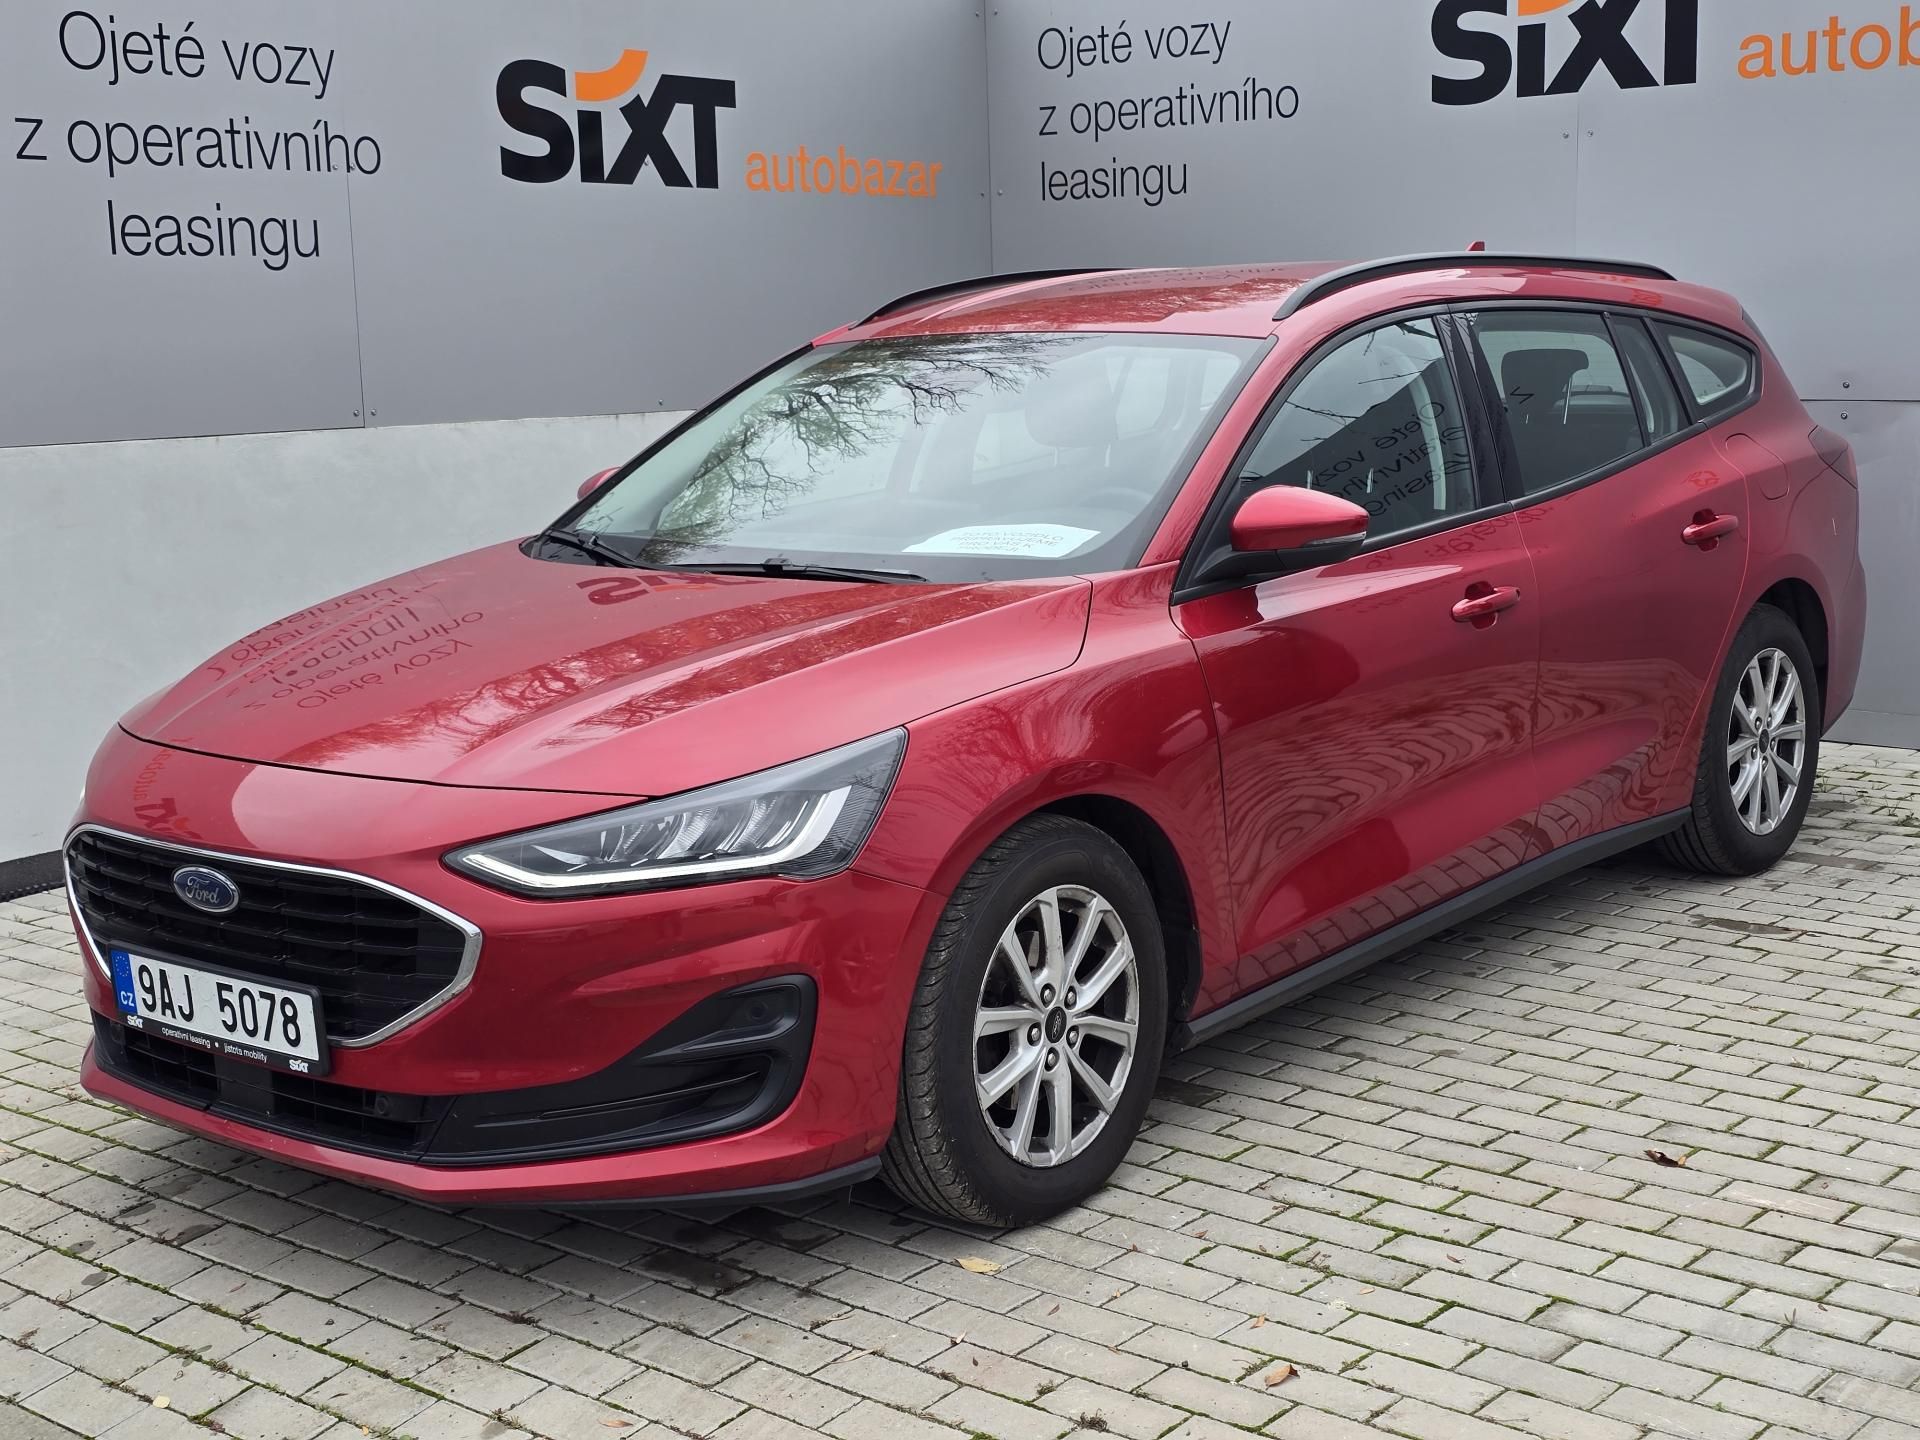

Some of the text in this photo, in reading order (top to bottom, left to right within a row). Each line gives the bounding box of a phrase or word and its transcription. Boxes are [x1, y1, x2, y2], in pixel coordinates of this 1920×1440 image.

[59, 11, 335, 99] Ojeté vozy
[1037, 20, 1231, 77] Ojeté vozy
[496, 49, 942, 198] SIXT autobazar
[1039, 77, 1299, 142] z operativního
[15, 116, 381, 177] z operativního
[1040, 158, 1187, 206] leasingu
[107, 200, 319, 271] leasingu
[185, 875, 220, 906] Ford
[120, 989, 135, 1007] CZ
[138, 963, 301, 1048] 9AJ 5078
[189, 1033, 211, 1049] leasing
[243, 1049, 268, 1063] mobility
